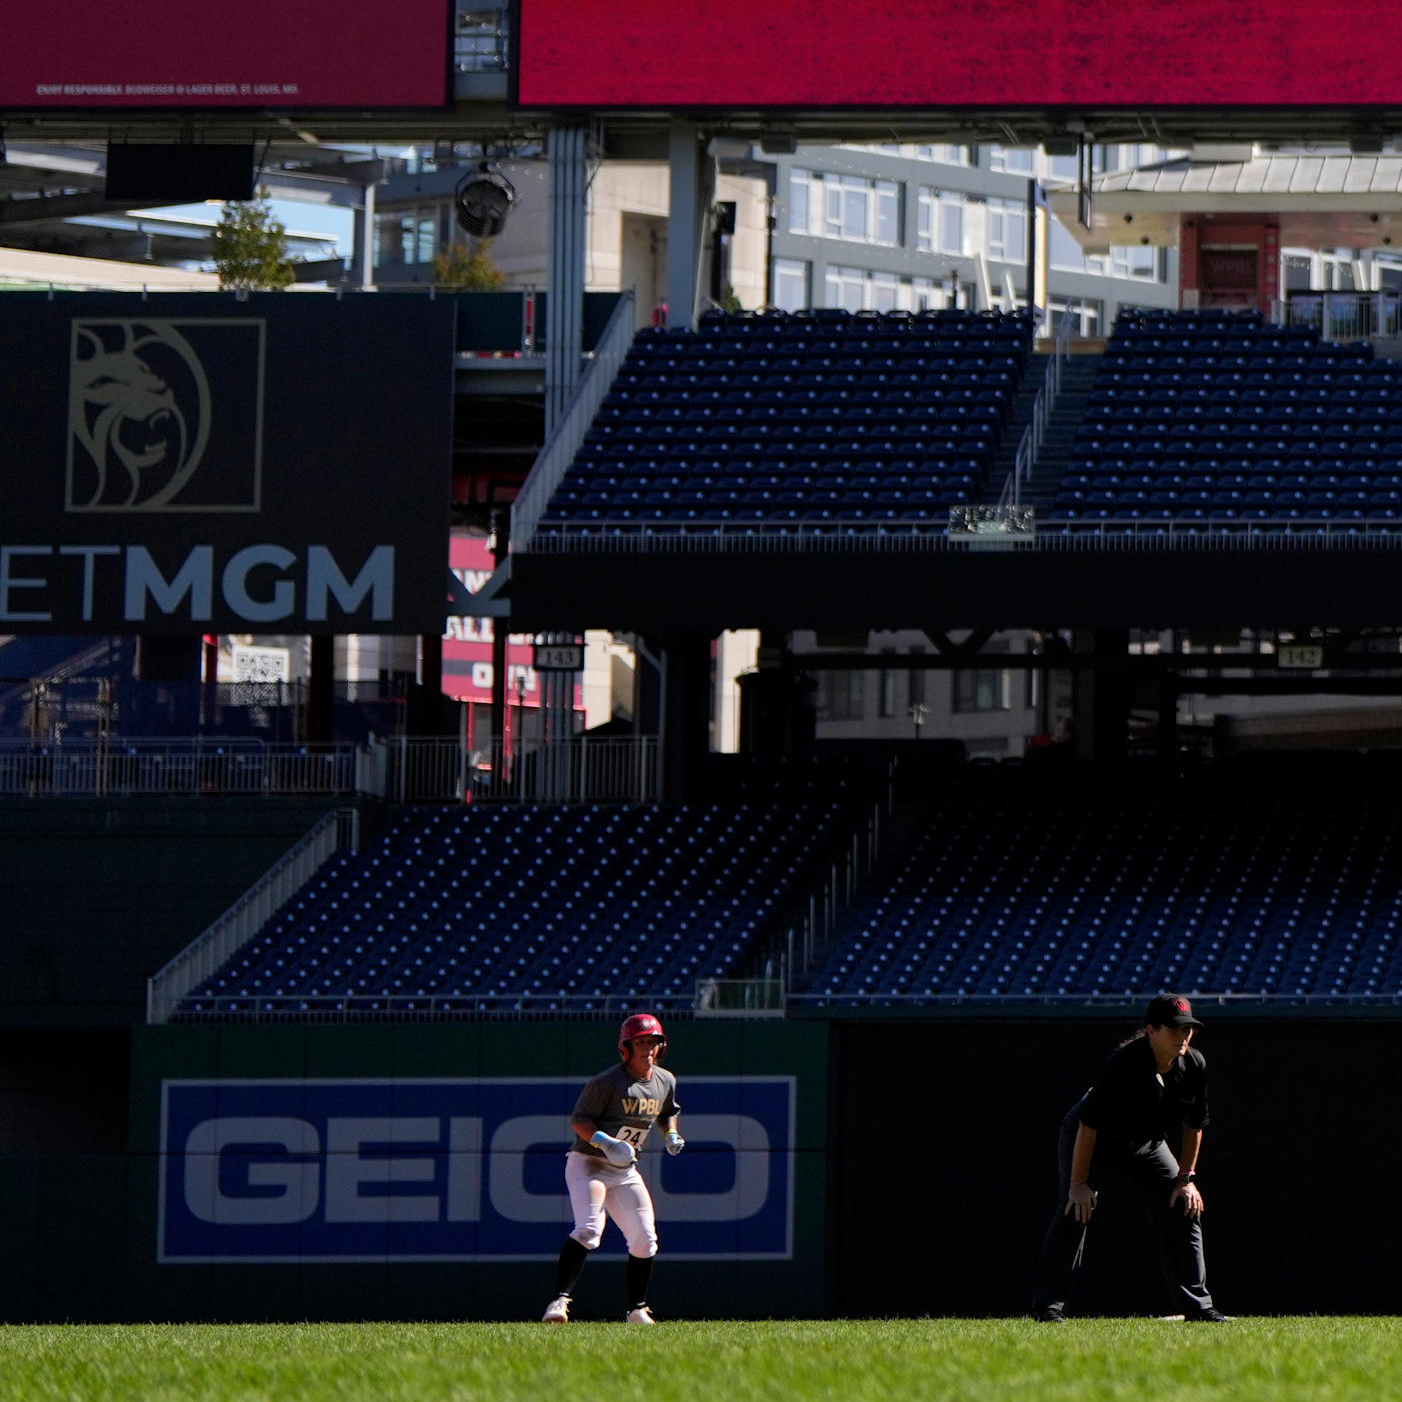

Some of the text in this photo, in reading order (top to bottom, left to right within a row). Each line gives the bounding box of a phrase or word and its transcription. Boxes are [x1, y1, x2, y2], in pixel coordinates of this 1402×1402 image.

[546, 650, 574, 666] 143
[621, 1097, 661, 1116] WPBL
[622, 1128, 642, 1147] 24
[183, 1113, 771, 1225] GEICO
